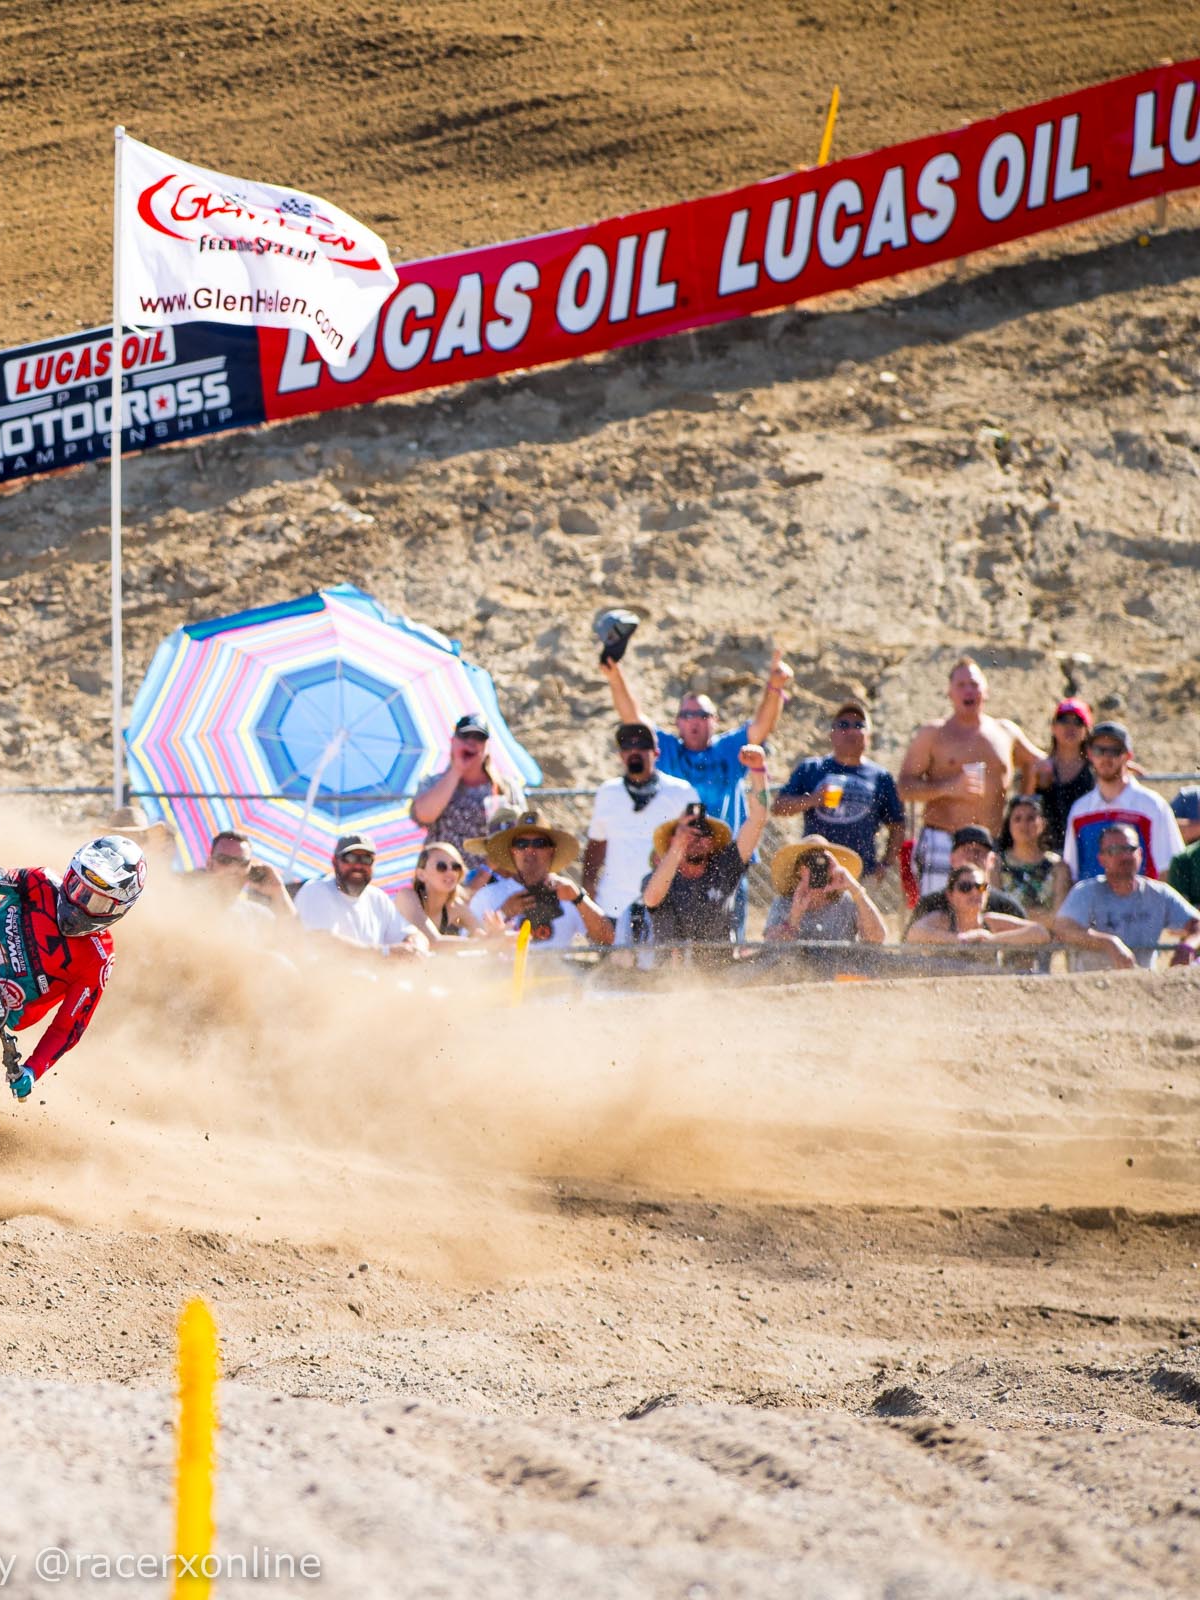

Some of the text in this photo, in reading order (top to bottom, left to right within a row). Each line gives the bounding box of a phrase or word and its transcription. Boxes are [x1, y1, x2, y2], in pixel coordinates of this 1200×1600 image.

[718, 113, 1090, 297] LUCAS OIL
[16, 331, 167, 395] LUCAS OIL
[139, 288, 344, 350] www.GlenHelen.com
[277, 228, 677, 395] LUCAS OIL
